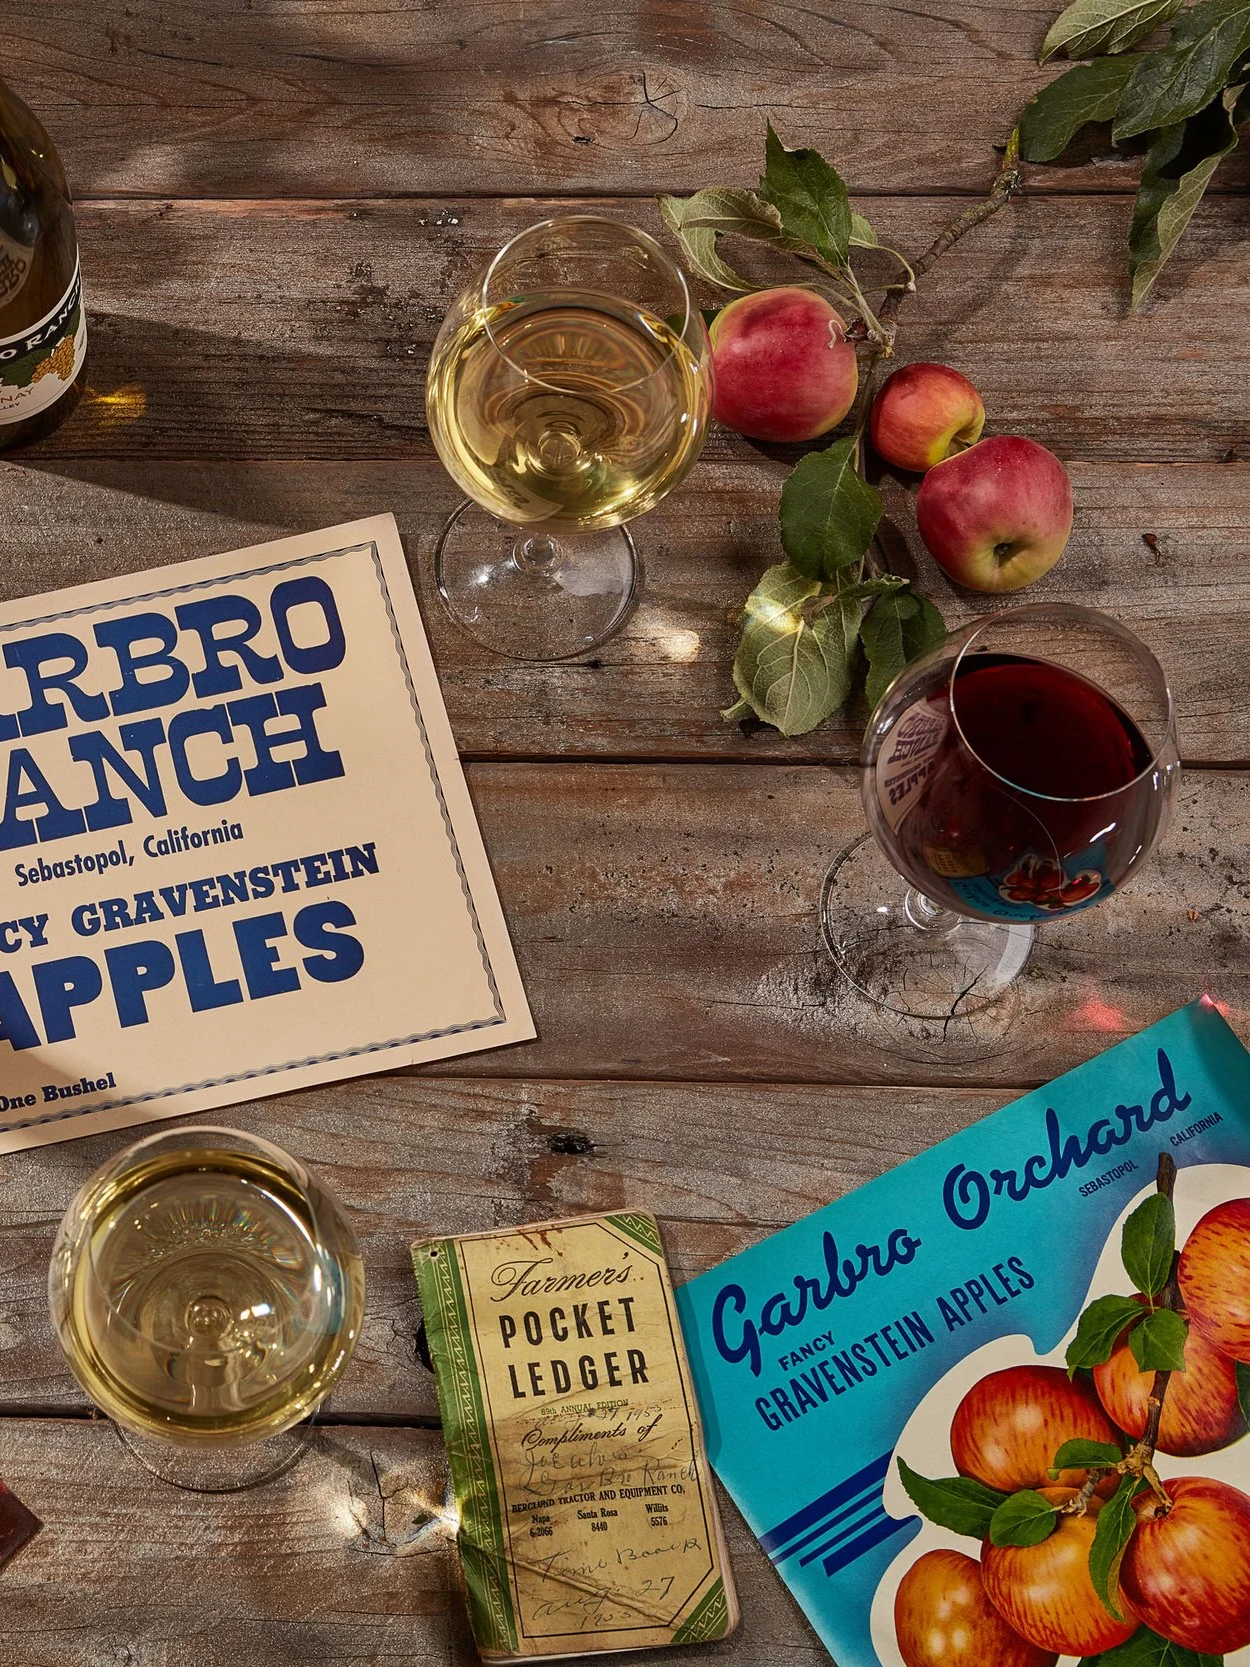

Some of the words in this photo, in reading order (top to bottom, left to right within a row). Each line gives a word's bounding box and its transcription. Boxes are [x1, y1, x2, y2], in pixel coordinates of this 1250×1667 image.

[14, 842, 135, 888] Sebastopol,
[143, 818, 245, 859] California
[71, 842, 381, 937] GRAVENSTEIN
[43, 1072, 117, 1104] Bushel
[1169, 1111, 1224, 1148] CALIFORNIA
[1078, 1159, 1139, 1199] SEBASTOPOL
[712, 1230, 922, 1378] Garbro
[942, 1047, 1193, 1231] Orchard
[490, 1252, 633, 1302] Farmer's
[499, 1297, 635, 1348] POCKET
[755, 1310, 936, 1432] GRAVENSTEIN
[935, 1256, 1036, 1332] APPLES
[777, 1331, 836, 1372] FANCY
[508, 1349, 649, 1399] LEDGER
[561, 1402, 595, 1414] ANNUAL
[597, 1398, 629, 1411] EDITION
[521, 1421, 626, 1453] Compliments
[637, 1413, 663, 1442] of
[512, 1498, 555, 1514] BERGLUND
[558, 1491, 596, 1505] TRACTOR
[599, 1489, 617, 1501] AND
[619, 1485, 668, 1499] EQUIPMENT
[670, 1483, 686, 1495] CO.
[531, 1514, 551, 1525] Napa
[577, 1509, 598, 1520] Santa
[600, 1507, 618, 1518] Rosa
[645, 1502, 669, 1514] Willits
[529, 1526, 553, 1537] 6-2066
[591, 1522, 608, 1532] 8440
[651, 1516, 667, 1526] 5576
